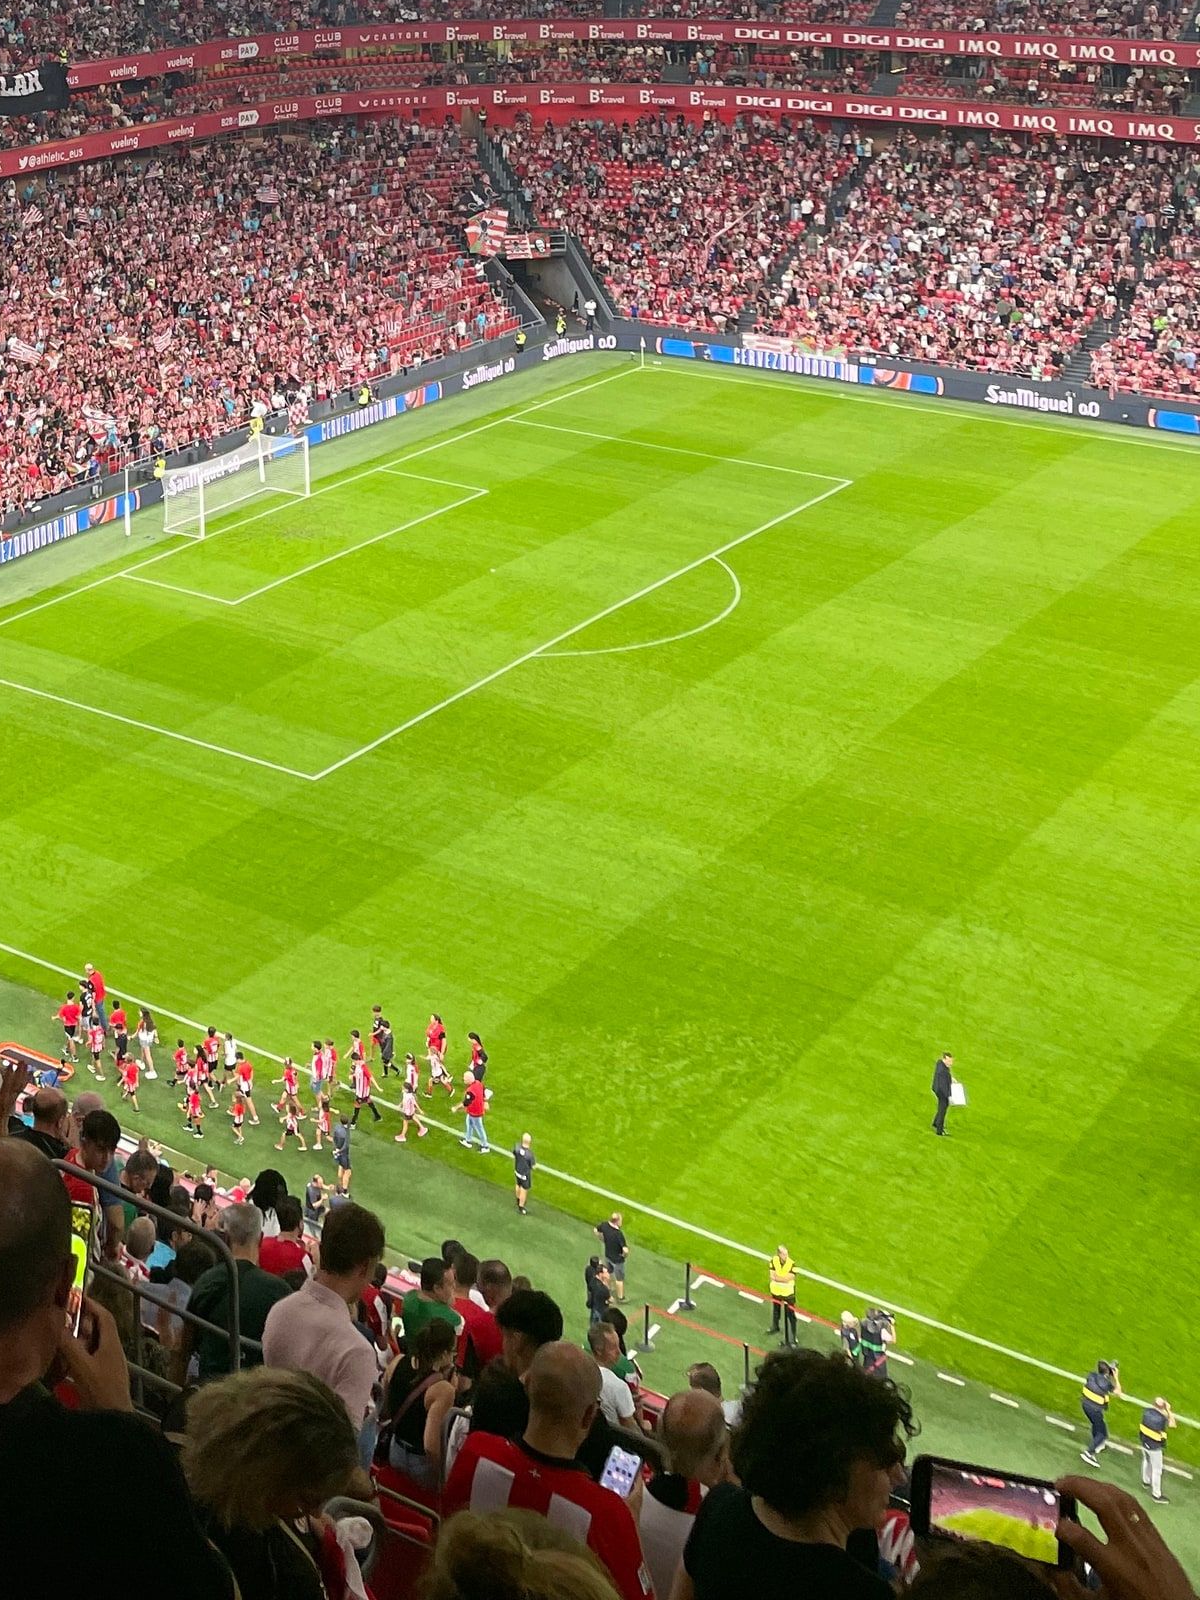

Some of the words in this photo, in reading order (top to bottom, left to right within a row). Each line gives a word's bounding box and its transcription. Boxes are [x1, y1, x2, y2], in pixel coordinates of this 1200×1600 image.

[314, 32, 342, 43] CLUB
[374, 31, 428, 41] CASTORE
[457, 32, 479, 40] travel
[504, 32, 526, 40] travel
[649, 32, 672, 40] travel
[700, 32, 723, 40] travel
[735, 28, 780, 40] DIGI
[787, 31, 832, 43] DIGI
[843, 34, 890, 46] DIGI
[274, 36, 299, 47] CLUB
[896, 36, 944, 49] DIGI
[959, 39, 1002, 56] IMQ
[1015, 42, 1060, 58] IMQ
[1070, 44, 1116, 62] IMQ
[167, 54, 194, 68] vueling
[1130, 48, 1177, 66] IMQ
[110, 64, 138, 78] vueling
[315, 98, 342, 109] CLUB
[373, 96, 427, 106] CASTORE
[552, 96, 574, 104] travel
[602, 96, 624, 104] travel
[652, 96, 675, 104] travel
[702, 98, 726, 106] travel
[736, 96, 781, 108] DIGI
[788, 99, 832, 112] DIGI
[274, 102, 298, 114] CLUB
[846, 104, 892, 116] DIGI
[899, 108, 947, 120] DIGI
[958, 110, 1001, 128] IMQ
[1014, 114, 1058, 132] IMQ
[168, 124, 194, 138] vueling
[1070, 118, 1114, 136] IMQ
[1128, 122, 1175, 140] IMQ
[110, 136, 138, 150] vueling
[542, 334, 594, 360] SanMiguel
[462, 360, 503, 390] SanMiguel
[984, 384, 1073, 414] SanMiguel
